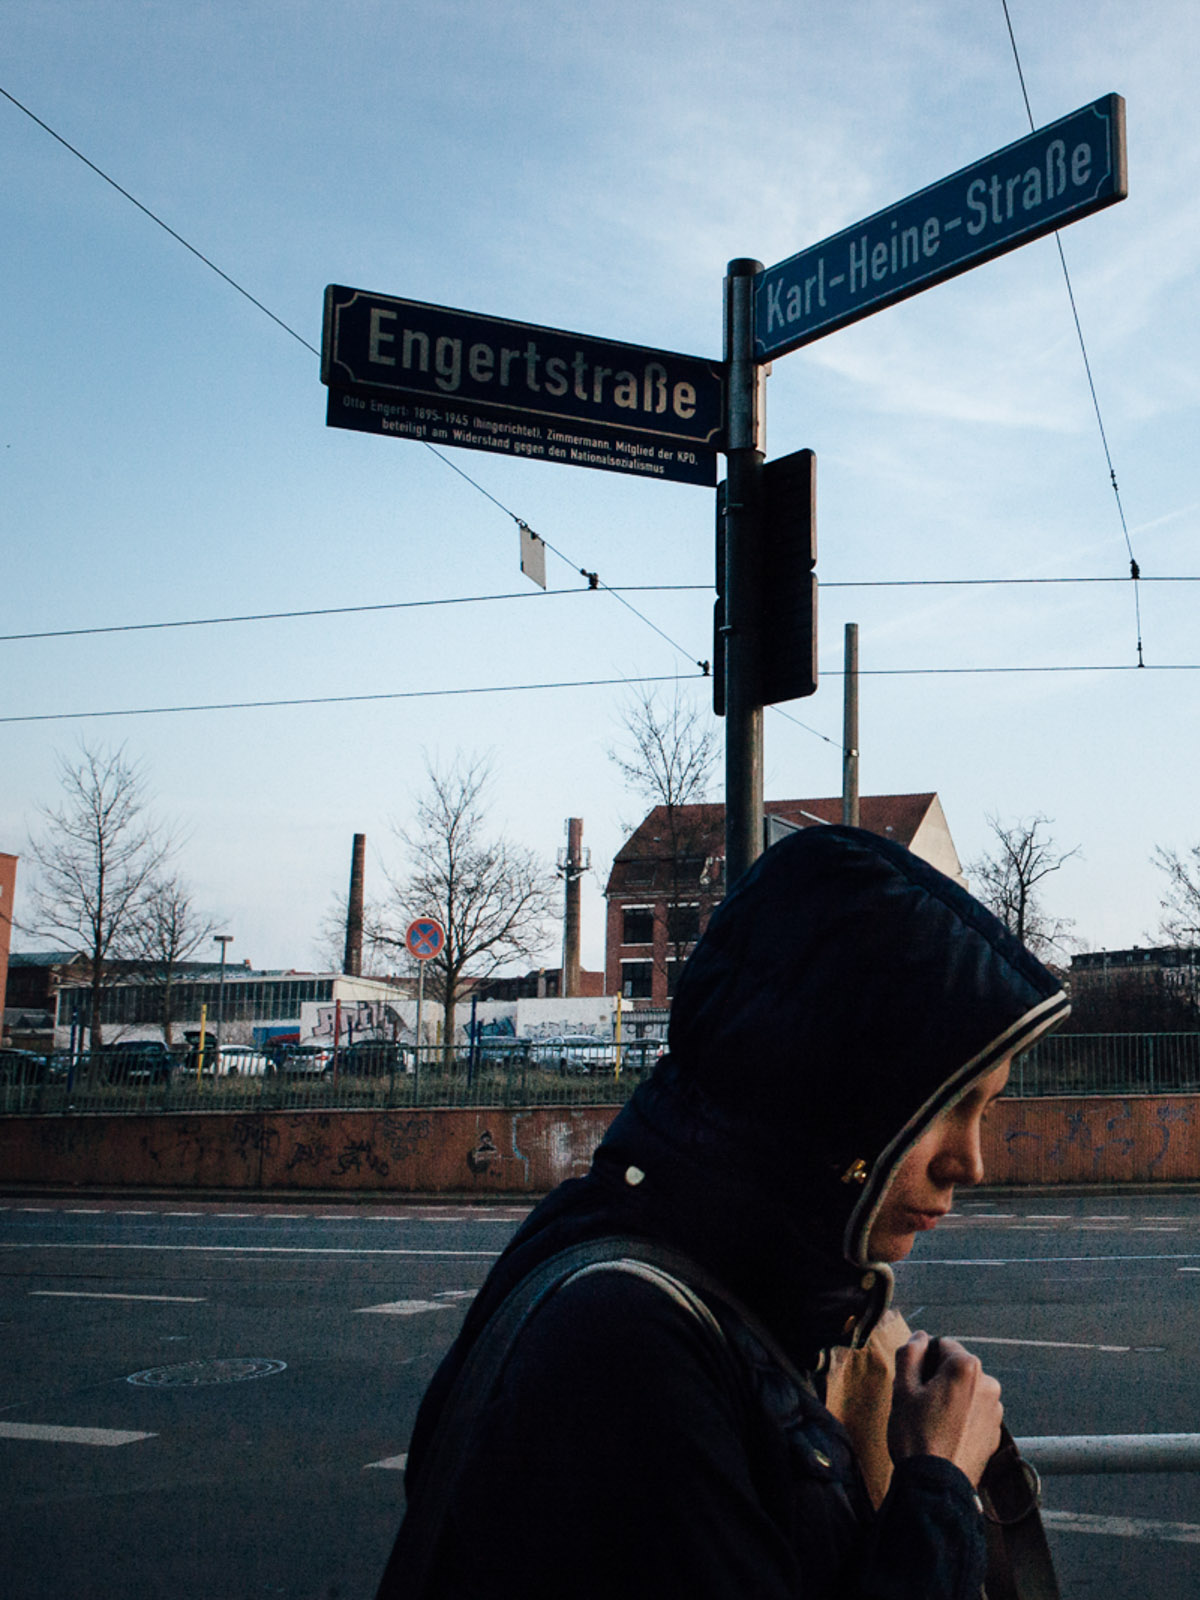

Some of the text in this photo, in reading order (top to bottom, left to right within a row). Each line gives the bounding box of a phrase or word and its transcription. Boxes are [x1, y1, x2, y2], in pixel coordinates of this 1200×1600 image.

[767, 138, 1092, 333] Karl-Heine-Straße
[368, 307, 697, 420] Engertstraße
[342, 395, 365, 410] Otto
[615, 440, 655, 458] Mitglied
[657, 448, 673, 461] der
[382, 417, 665, 474] beteiligt am Widerstand gegen den Nationalsozialismus
